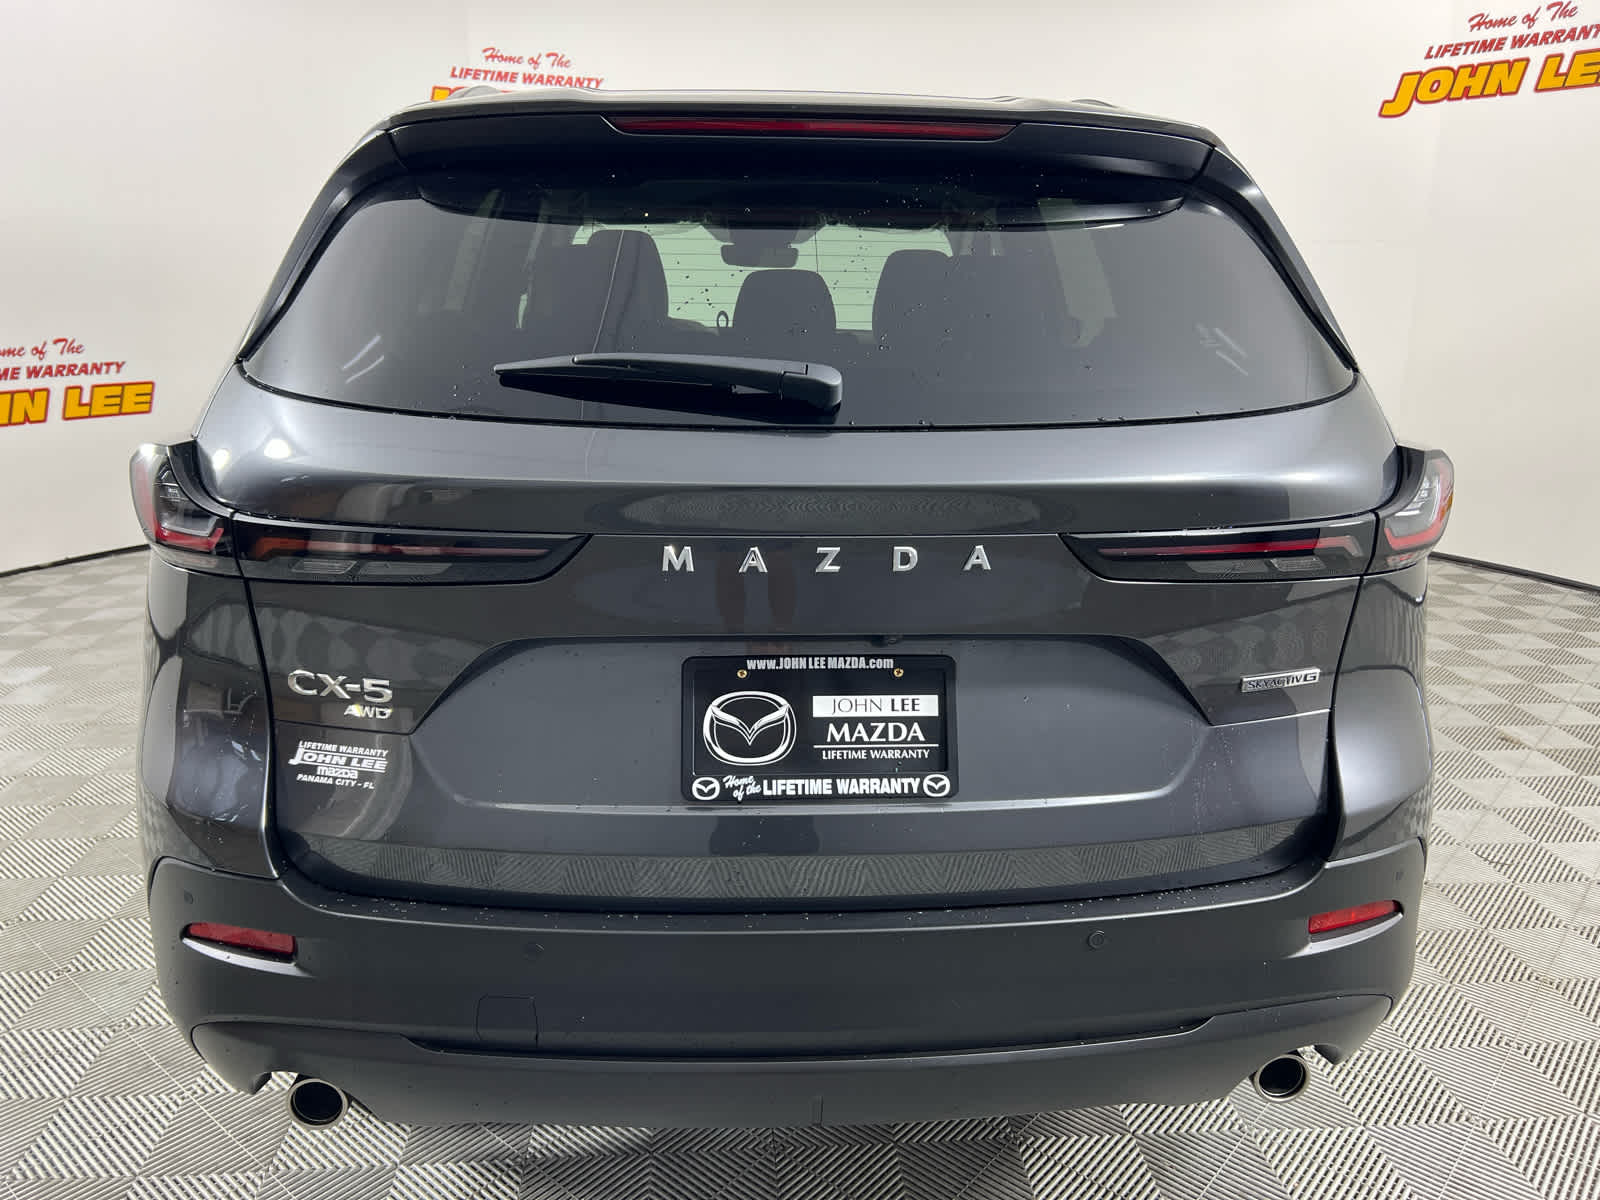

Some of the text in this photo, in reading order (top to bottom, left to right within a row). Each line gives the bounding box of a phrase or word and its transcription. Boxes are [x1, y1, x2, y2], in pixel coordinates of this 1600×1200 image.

[1468, 0, 1578, 32] Home of The
[482, 46, 572, 70] Home of The
[1424, 36, 1507, 60] LIFETIME
[450, 66, 604, 89] LIFETIME WARRANTY
[1378, 48, 1600, 118] JOHN LE
[31, 340, 47, 361] of
[53, 338, 85, 355] The
[26, 361, 126, 379] WARRANTY
[62, 381, 155, 421] LEE
[662, 545, 992, 573] MAZDA
[287, 669, 393, 703] CX-5
[344, 704, 393, 719] AWD
[831, 697, 921, 715] JOHN LEE
[826, 722, 926, 743] MAZDA
[288, 748, 389, 771] JOHN LEE
[299, 740, 389, 757] LIFETIME WARRANTY
[822, 749, 931, 760] LIFETIME WARRANTY
[296, 773, 333, 785] PANAMA
[335, 778, 357, 788] CITY
[362, 781, 375, 790] FL
[722, 775, 754, 789] Home
[733, 781, 762, 801] of the
[763, 777, 920, 796] LIFETIME WARRANTY
